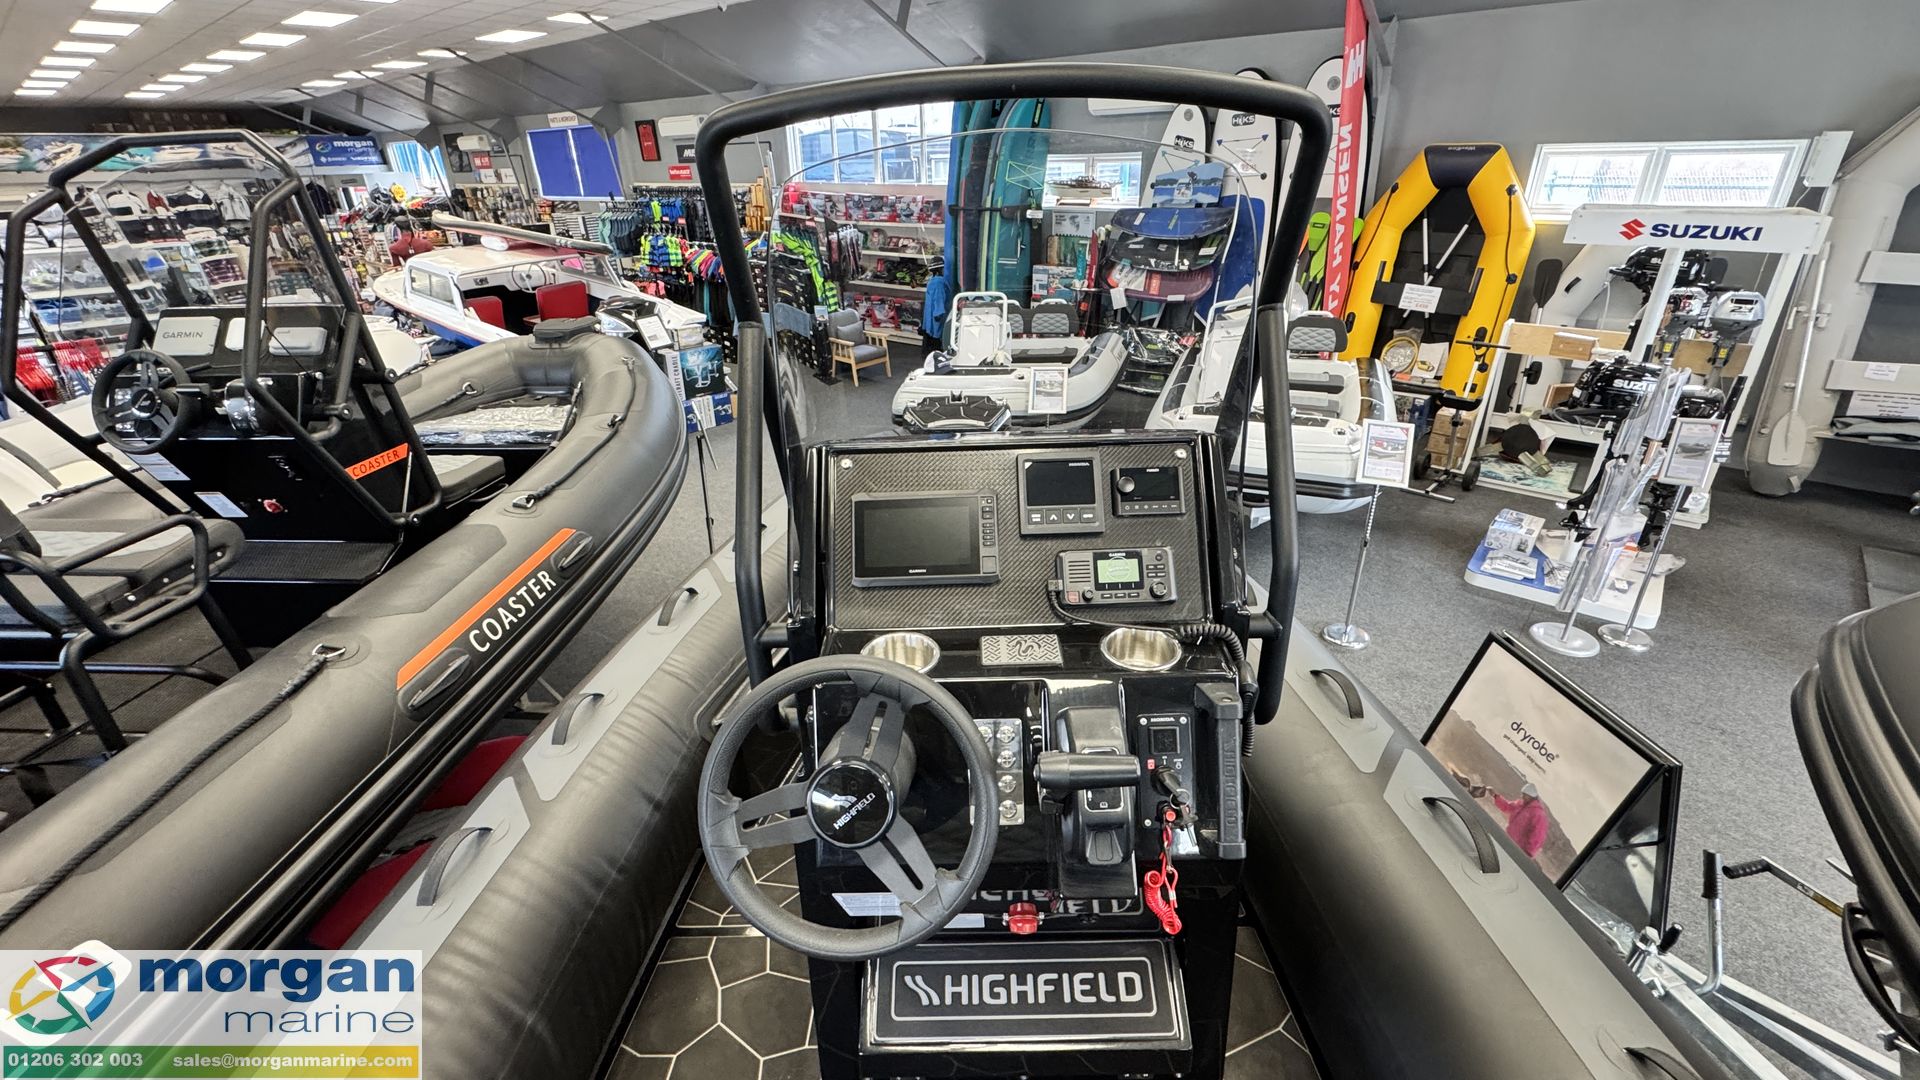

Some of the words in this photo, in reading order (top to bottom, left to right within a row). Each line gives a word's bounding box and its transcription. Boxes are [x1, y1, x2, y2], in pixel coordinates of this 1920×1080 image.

[1232, 115, 1255, 125] HIKS
[1174, 137, 1195, 148] HIKS
[1649, 222, 1763, 241] SUZUKI
[1650, 257, 1688, 267] SUKI
[162, 331, 203, 339] GARMIN
[352, 450, 400, 477] COASTER
[469, 570, 556, 652] COASTER
[833, 792, 876, 830] HIGHFIELD
[945, 971, 1144, 1006] HIGHFIELD
